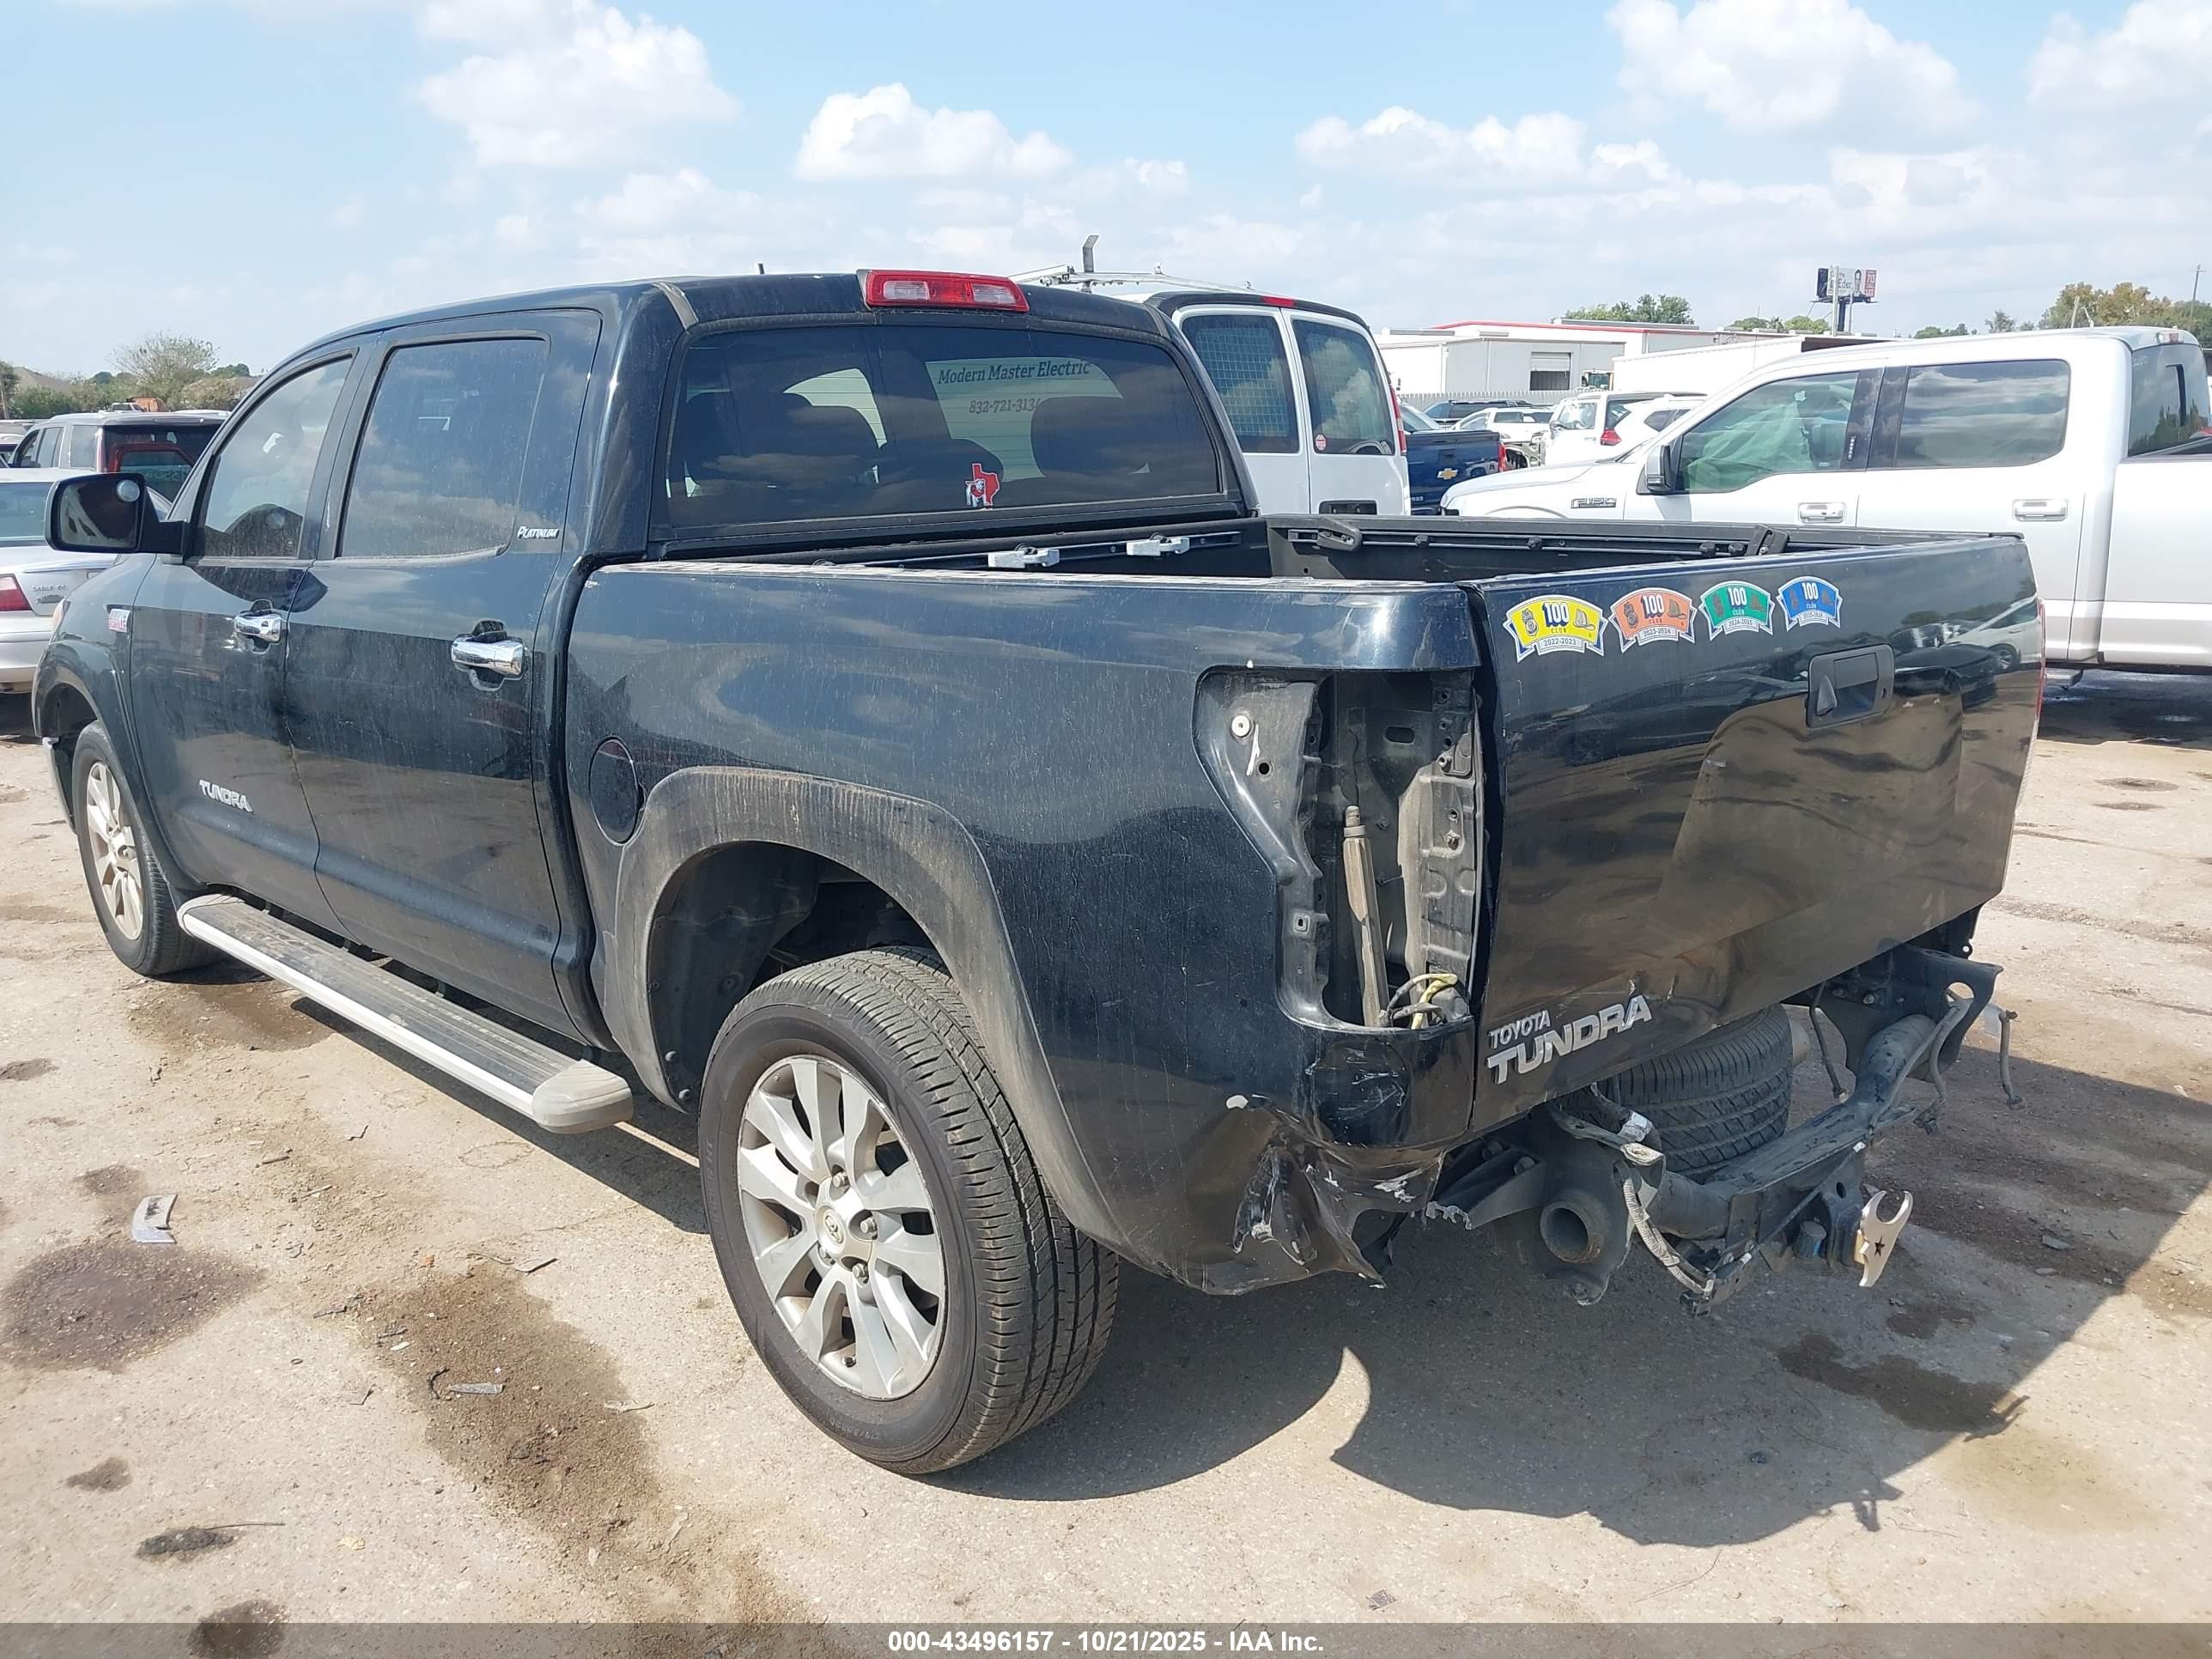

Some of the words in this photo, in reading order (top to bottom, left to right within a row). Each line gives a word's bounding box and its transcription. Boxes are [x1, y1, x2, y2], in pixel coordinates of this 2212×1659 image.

[939, 367, 986, 384] Modern
[988, 364, 1036, 380] Master
[1036, 360, 1091, 377] Electric
[1727, 586, 1747, 606] 100
[1802, 582, 1820, 600] 100
[1542, 601, 1570, 625] 100
[1642, 593, 1665, 617] 100
[1544, 637, 1577, 647] 2022-2023
[1643, 628, 1671, 637] 2023-2024
[198, 779, 254, 813] TUNDRA
[1486, 994, 1653, 1085] TUNDRA
[1488, 1009, 1552, 1049] TOYOTA
